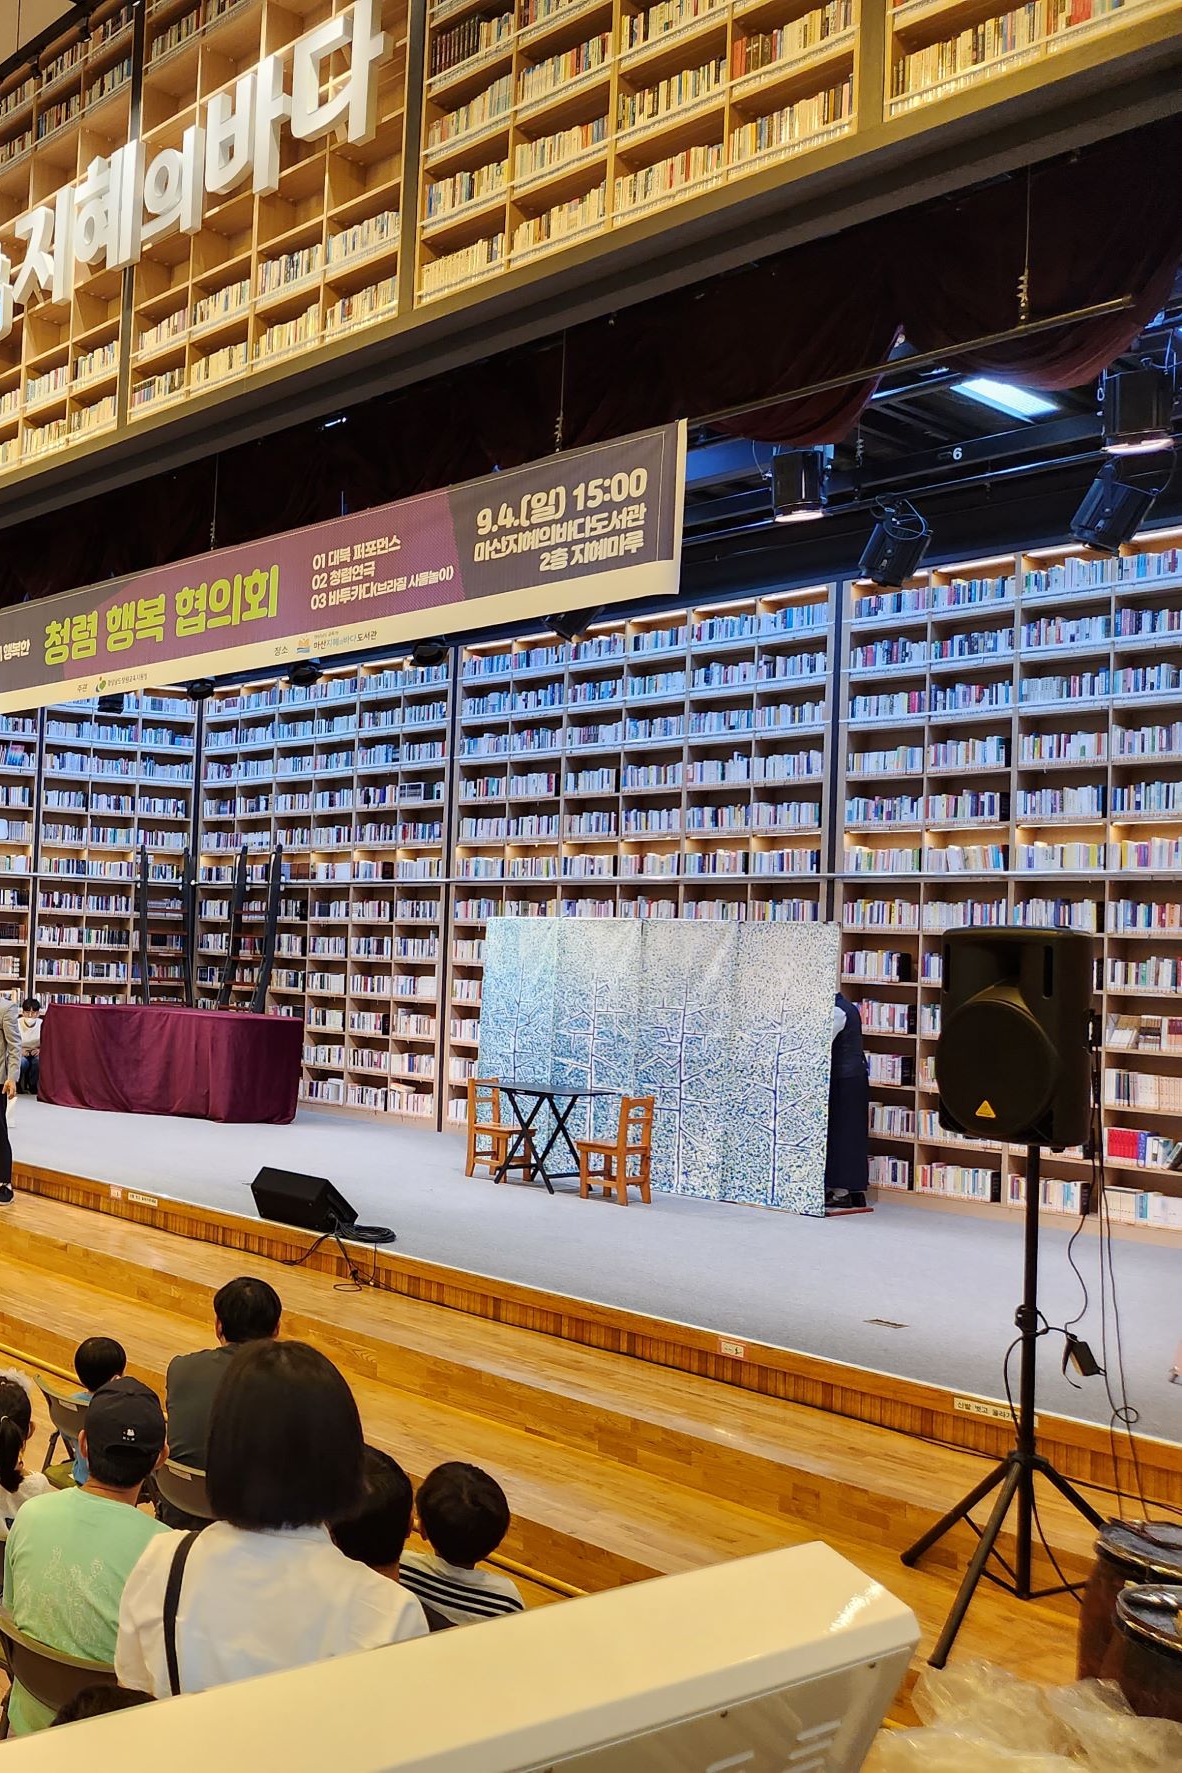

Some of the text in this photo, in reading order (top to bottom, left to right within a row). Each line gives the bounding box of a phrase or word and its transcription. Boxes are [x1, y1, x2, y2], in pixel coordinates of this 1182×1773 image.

[953, 447, 963, 460] 6
[476, 467, 648, 535] 9.4.(일) 15:00
[473, 502, 647, 562] 마산지혜의바다도서관
[539, 530, 644, 572] 2층 지혜마루
[312, 535, 402, 571] 01 대북 퍼포먼스
[310, 594, 327, 610] 03
[408, 565, 454, 589] 사물놀이)
[311, 561, 376, 590] 02 청렴연극
[44, 564, 280, 666] 청렴 행복 협의회
[3, 639, 31, 658] 행복한
[274, 646, 288, 656] 장소
